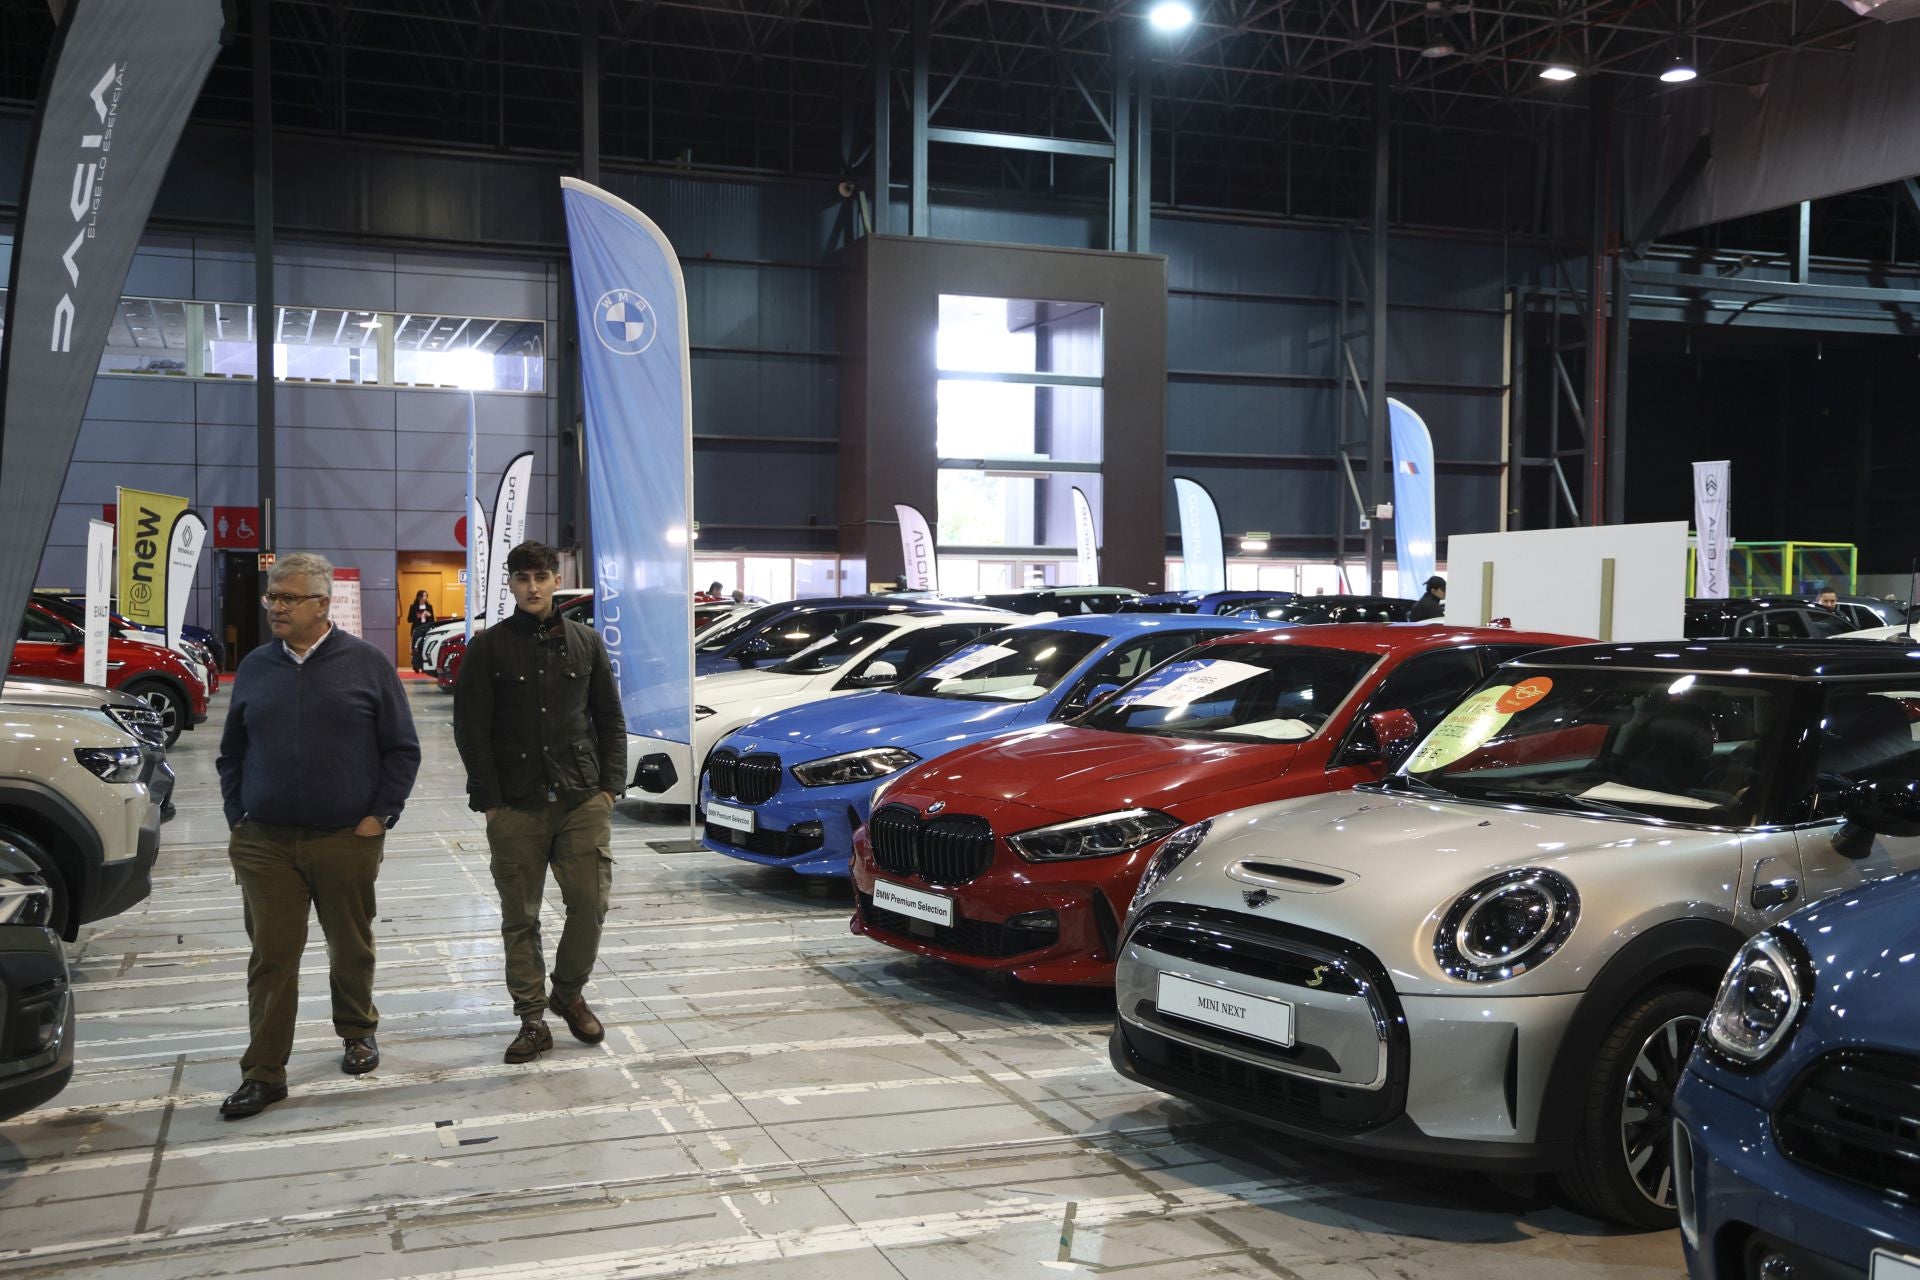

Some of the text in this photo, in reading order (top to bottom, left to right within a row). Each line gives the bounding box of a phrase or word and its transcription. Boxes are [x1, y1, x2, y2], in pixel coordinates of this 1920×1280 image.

[87, 61, 128, 238] ELIGE LO ESENCIAL
[51, 62, 116, 352] DACIA
[129, 506, 161, 617] renew
[732, 814, 750, 825] Selection
[875, 889, 948, 916] BMW Premium Selection
[1197, 996, 1246, 1019] MINI NEXT
